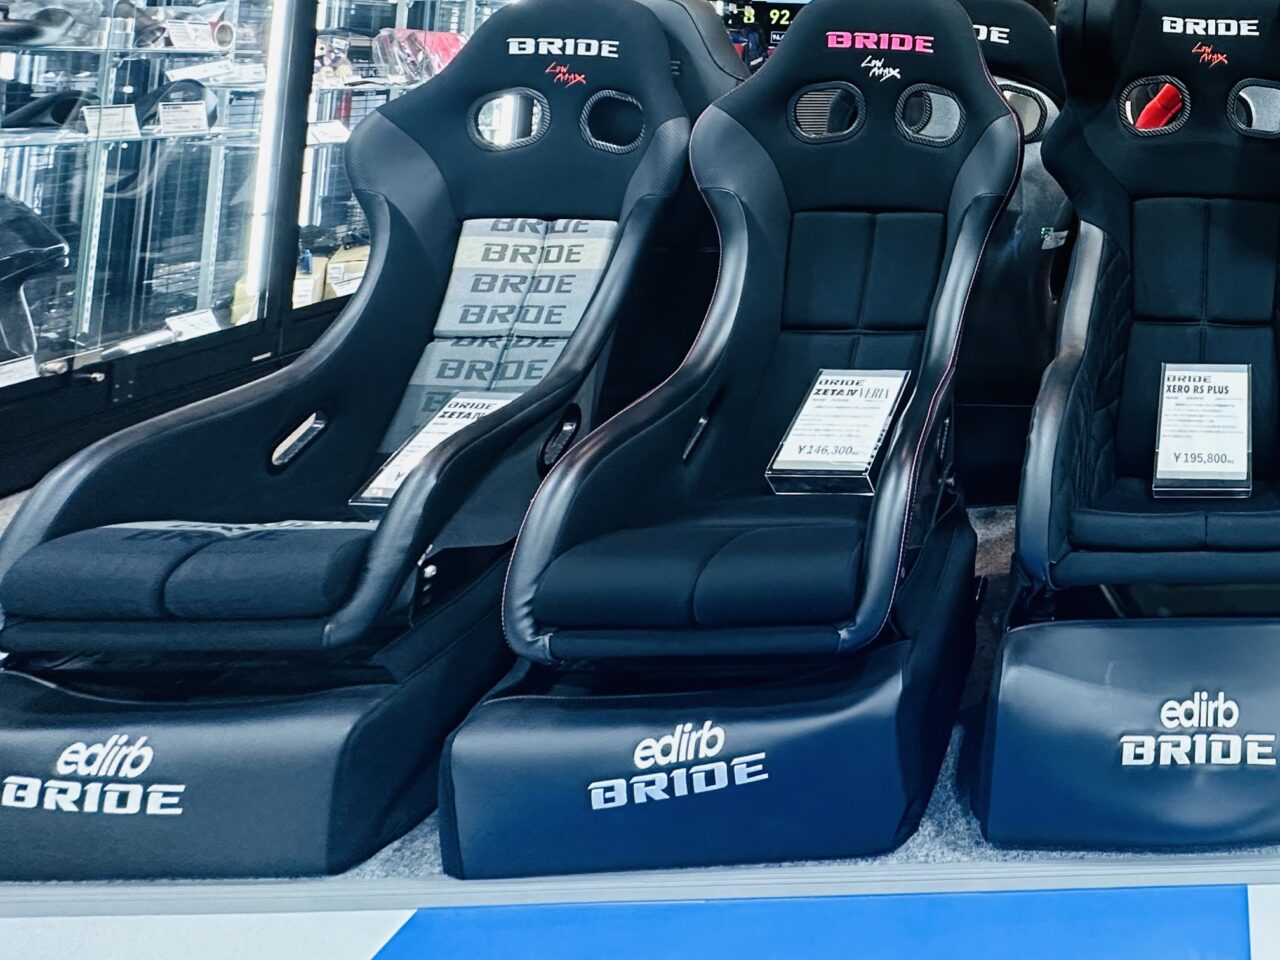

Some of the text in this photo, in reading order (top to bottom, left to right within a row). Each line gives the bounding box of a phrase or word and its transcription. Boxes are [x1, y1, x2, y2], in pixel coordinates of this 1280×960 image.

[1162, 16, 1260, 36] BRIDE
[507, 37, 619, 59] BRIDE
[826, 31, 934, 54] BRIDE
[490, 218, 591, 235] BRDE
[480, 243, 585, 265] BRDE
[470, 273, 577, 294] BRDE
[458, 304, 567, 325] BRDE
[435, 358, 548, 382] BRDE
[1166, 384, 1229, 395] XERO RS PLUS
[1173, 451, 1228, 465] ¥195,800
[1160, 690, 1240, 730] edirb
[56, 734, 155, 779] edirb
[632, 720, 727, 771] edirb
[1120, 733, 1277, 766] BRIDE
[588, 751, 769, 811] BRIDE
[1, 776, 186, 816] BRIDE
